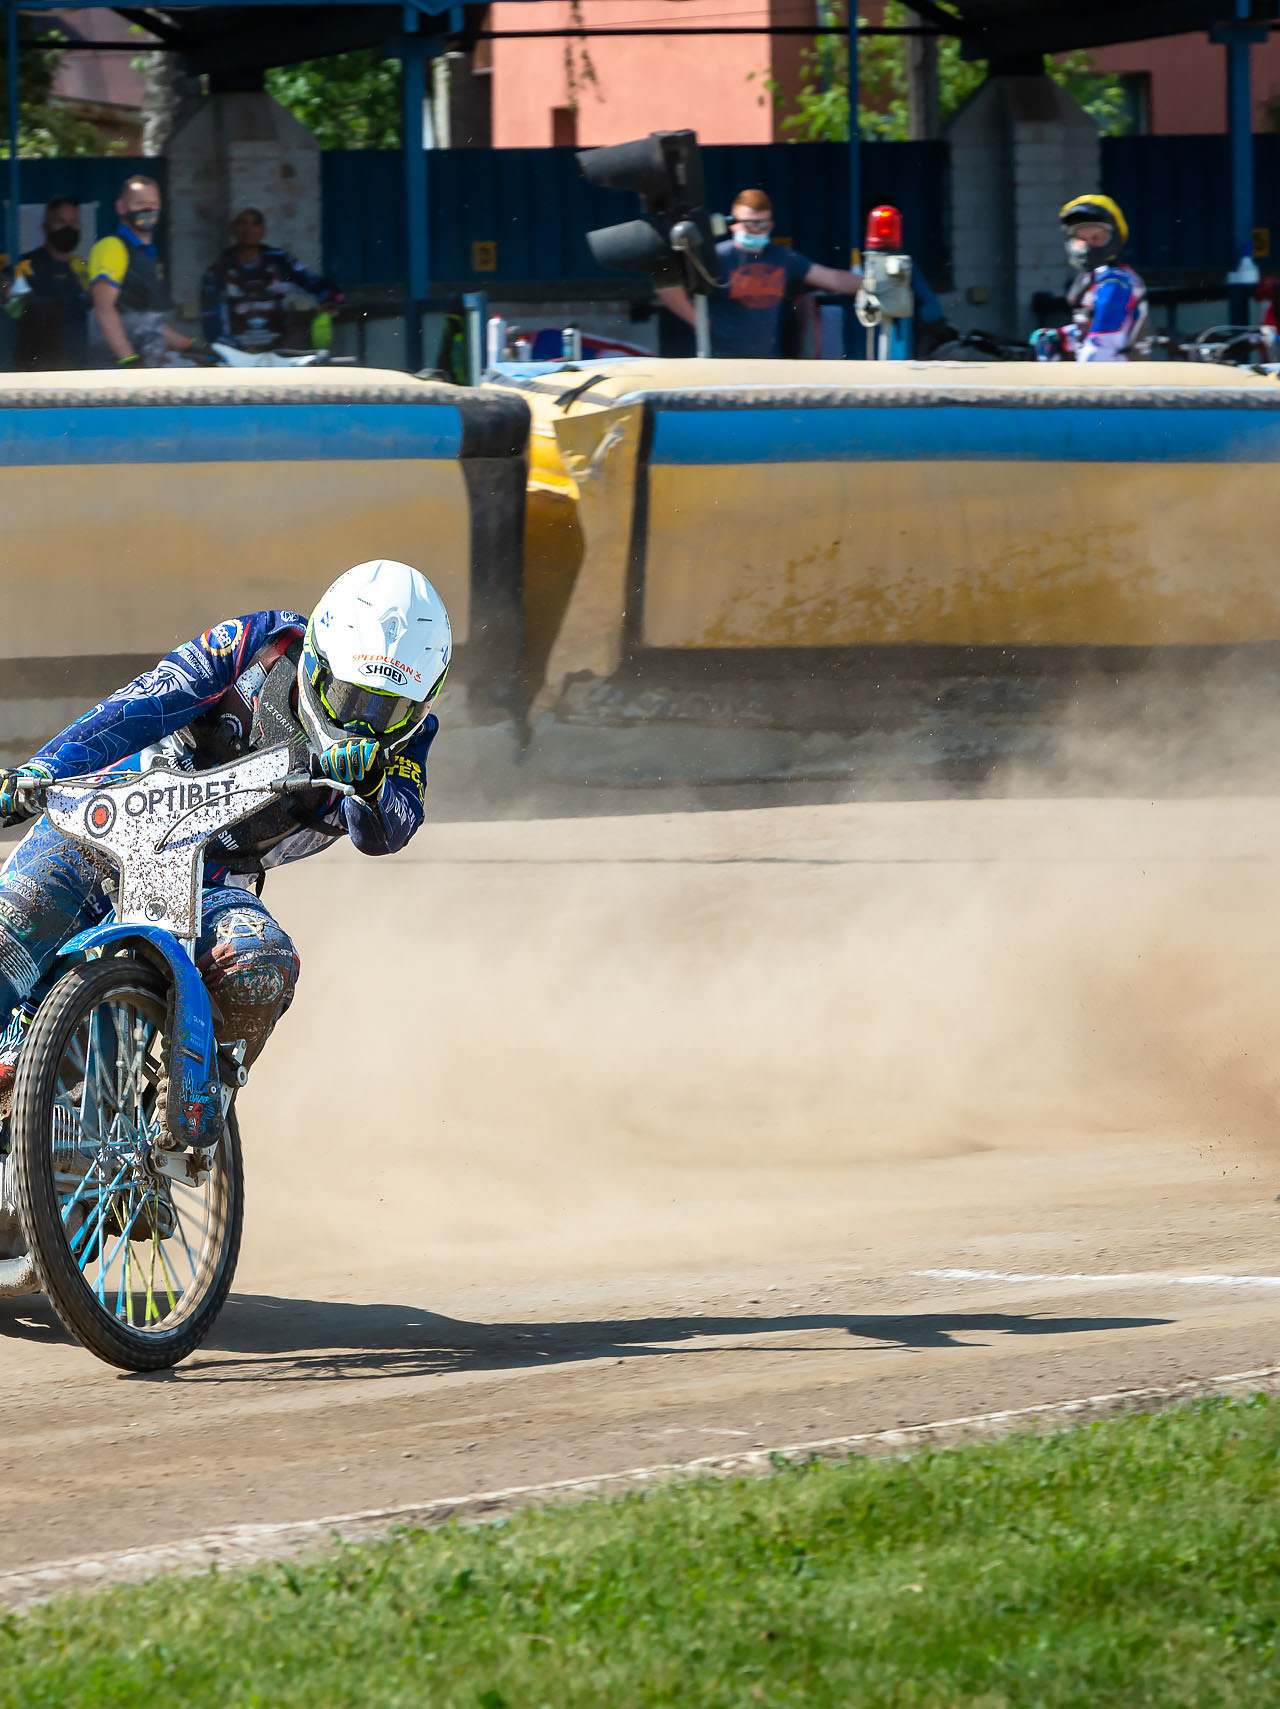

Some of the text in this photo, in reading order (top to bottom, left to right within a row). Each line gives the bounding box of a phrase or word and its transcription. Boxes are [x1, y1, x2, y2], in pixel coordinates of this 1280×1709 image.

[365, 664, 403, 684] SHOEI
[262, 701, 296, 733] AZTORIN
[124, 779, 235, 817] OPTIBET
